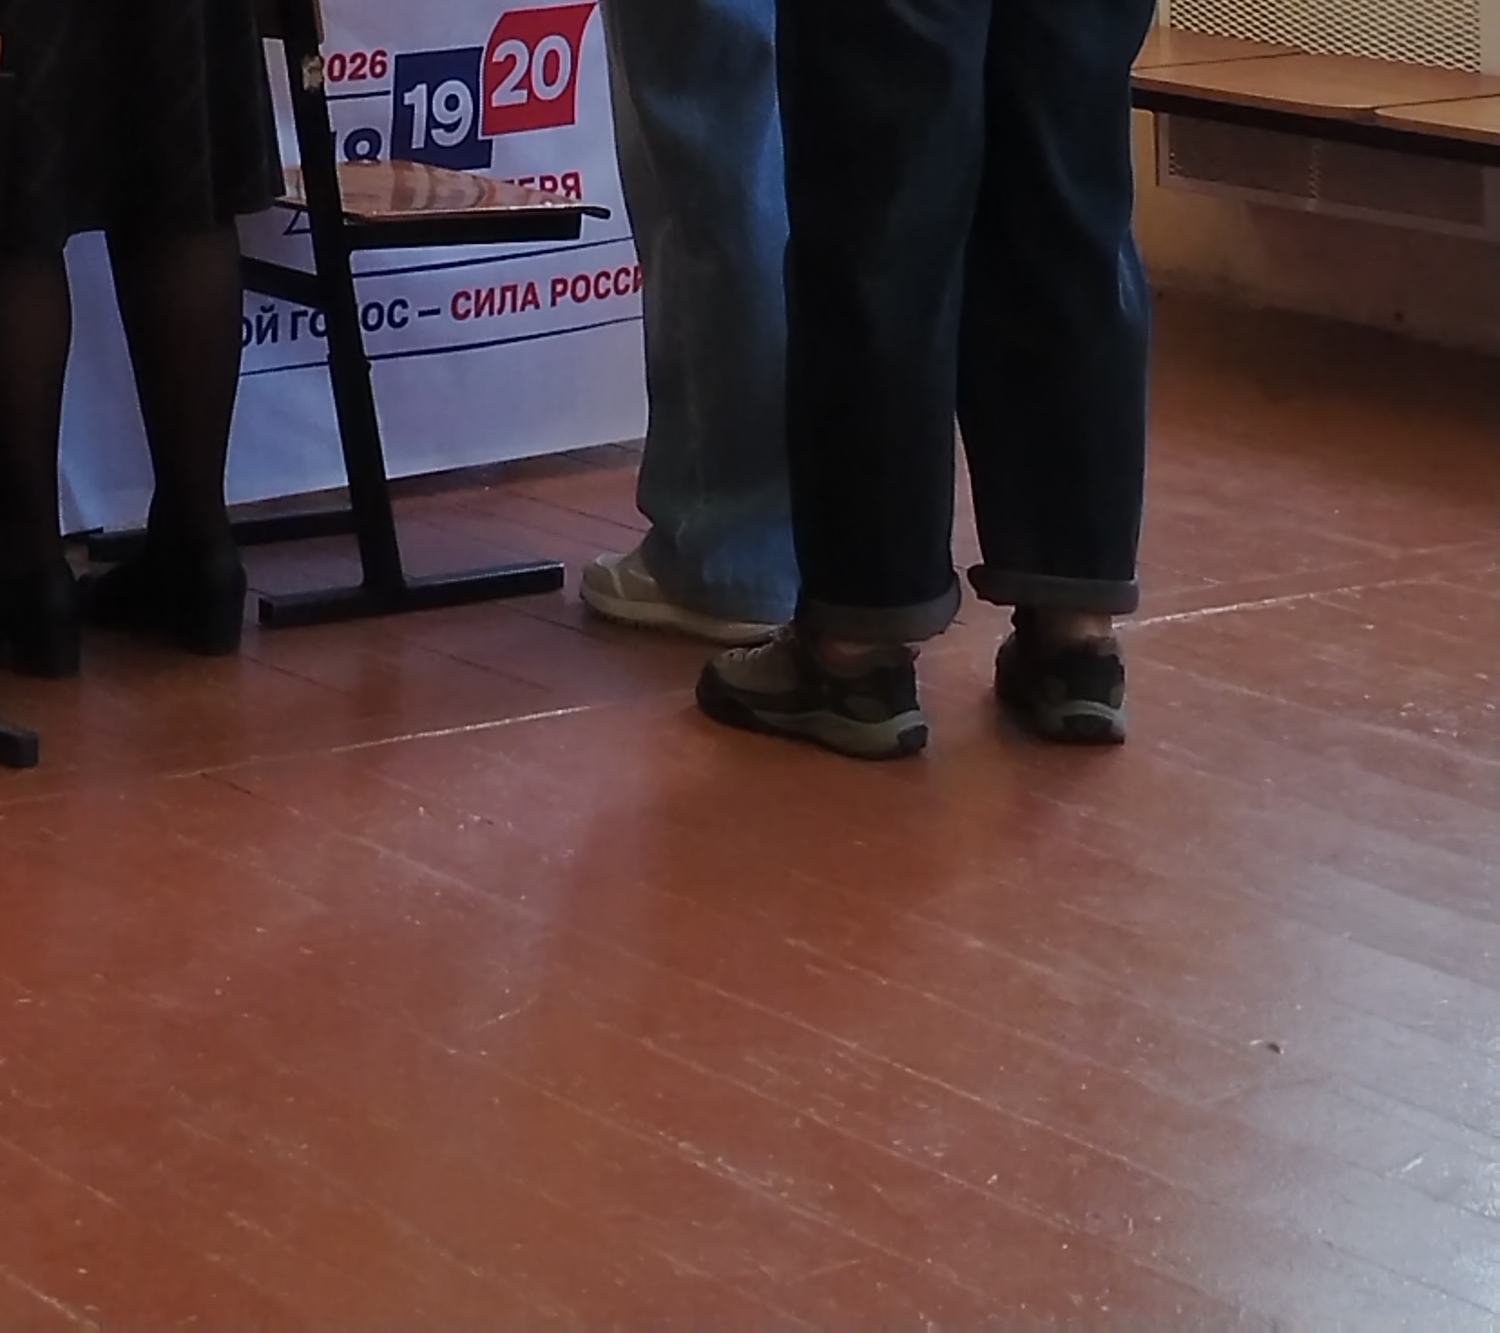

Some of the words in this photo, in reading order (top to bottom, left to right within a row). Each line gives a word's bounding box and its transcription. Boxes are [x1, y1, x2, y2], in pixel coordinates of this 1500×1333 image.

[322, 49, 388, 82] 026
[490, 34, 573, 108] 20
[403, 79, 475, 150] 19
[290, 299, 408, 342] ГООС
[450, 281, 541, 321] СИЛА
